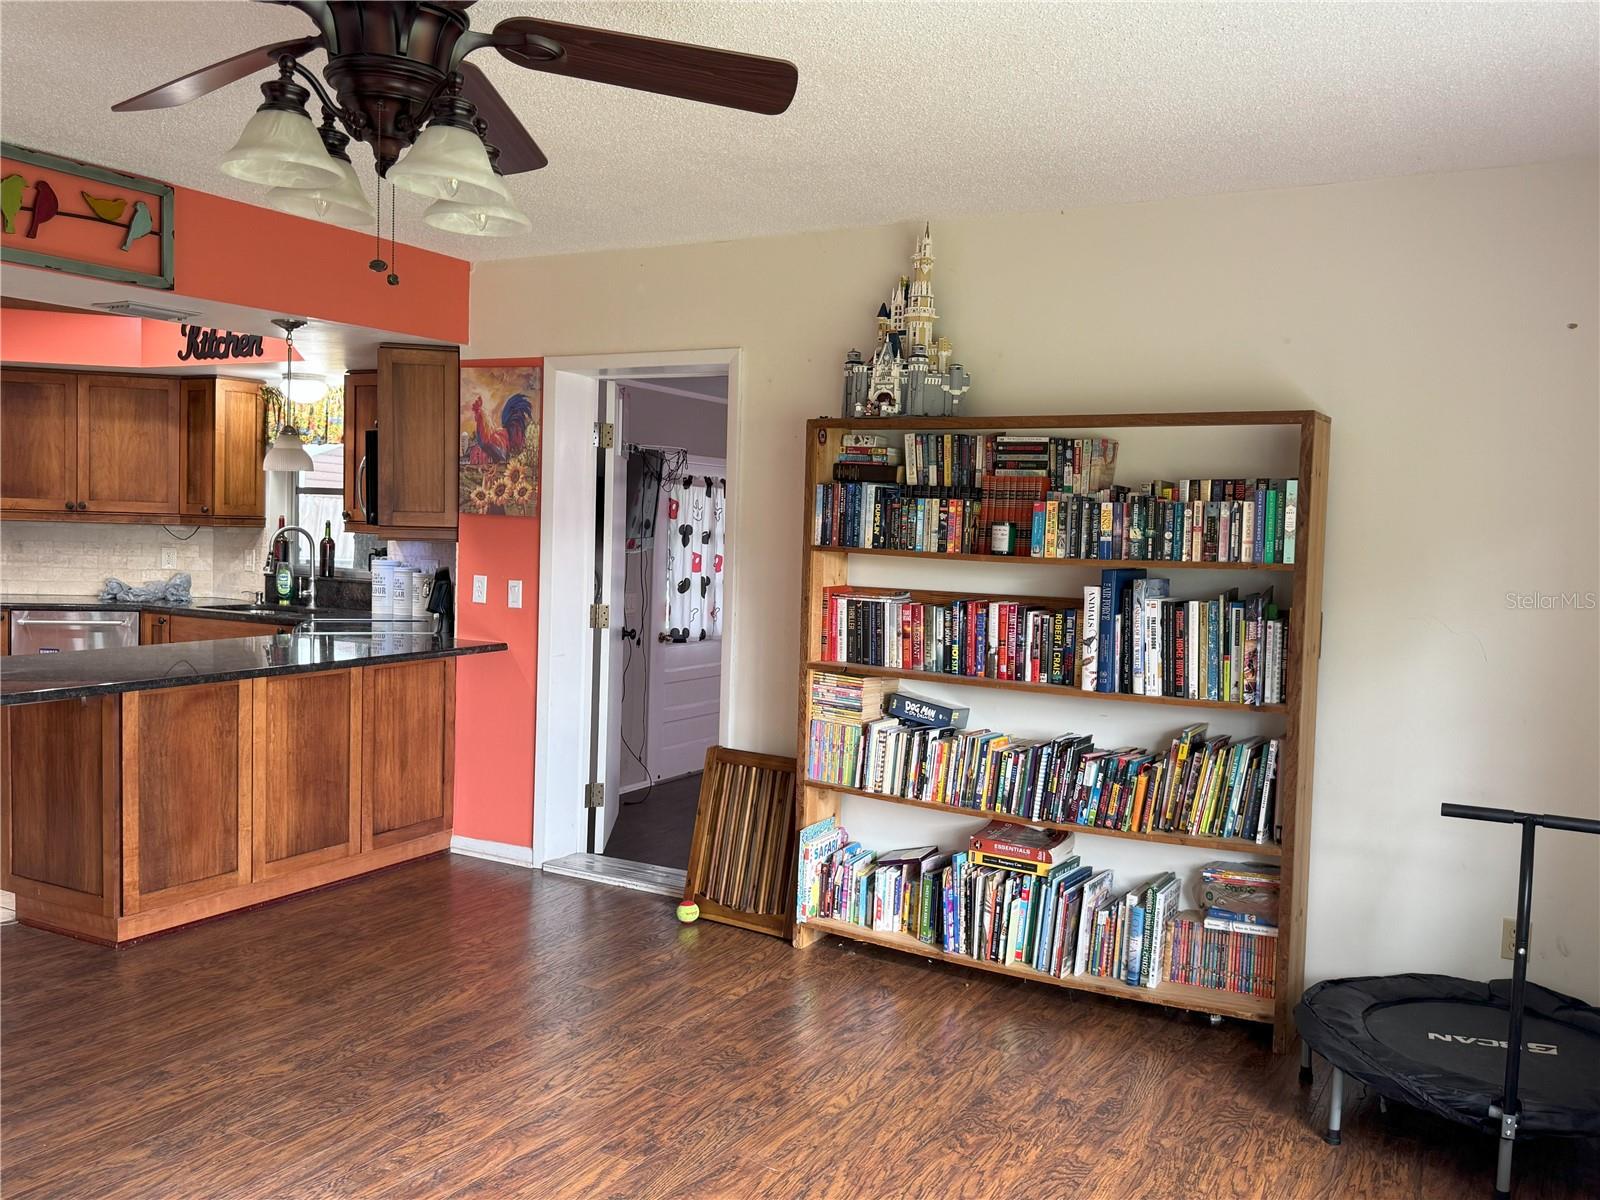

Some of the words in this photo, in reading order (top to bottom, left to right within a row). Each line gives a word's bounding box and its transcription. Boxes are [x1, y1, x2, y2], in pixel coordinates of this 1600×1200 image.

[178, 324, 263, 361] Kitchen
[1087, 591, 1096, 628] ANIMALS
[1101, 599, 1111, 620] FORCE
[1054, 613, 1063, 645] ROBERT
[1175, 638, 1184, 658] HOME
[1052, 652, 1061, 675] CRAIS
[1175, 659, 1184, 686] HOW-TO
[905, 700, 920, 712] DOG
[920, 705, 937, 718] MAN
[814, 839, 839, 860] SAFARI
[994, 843, 1031, 855] ESSENTIALS
